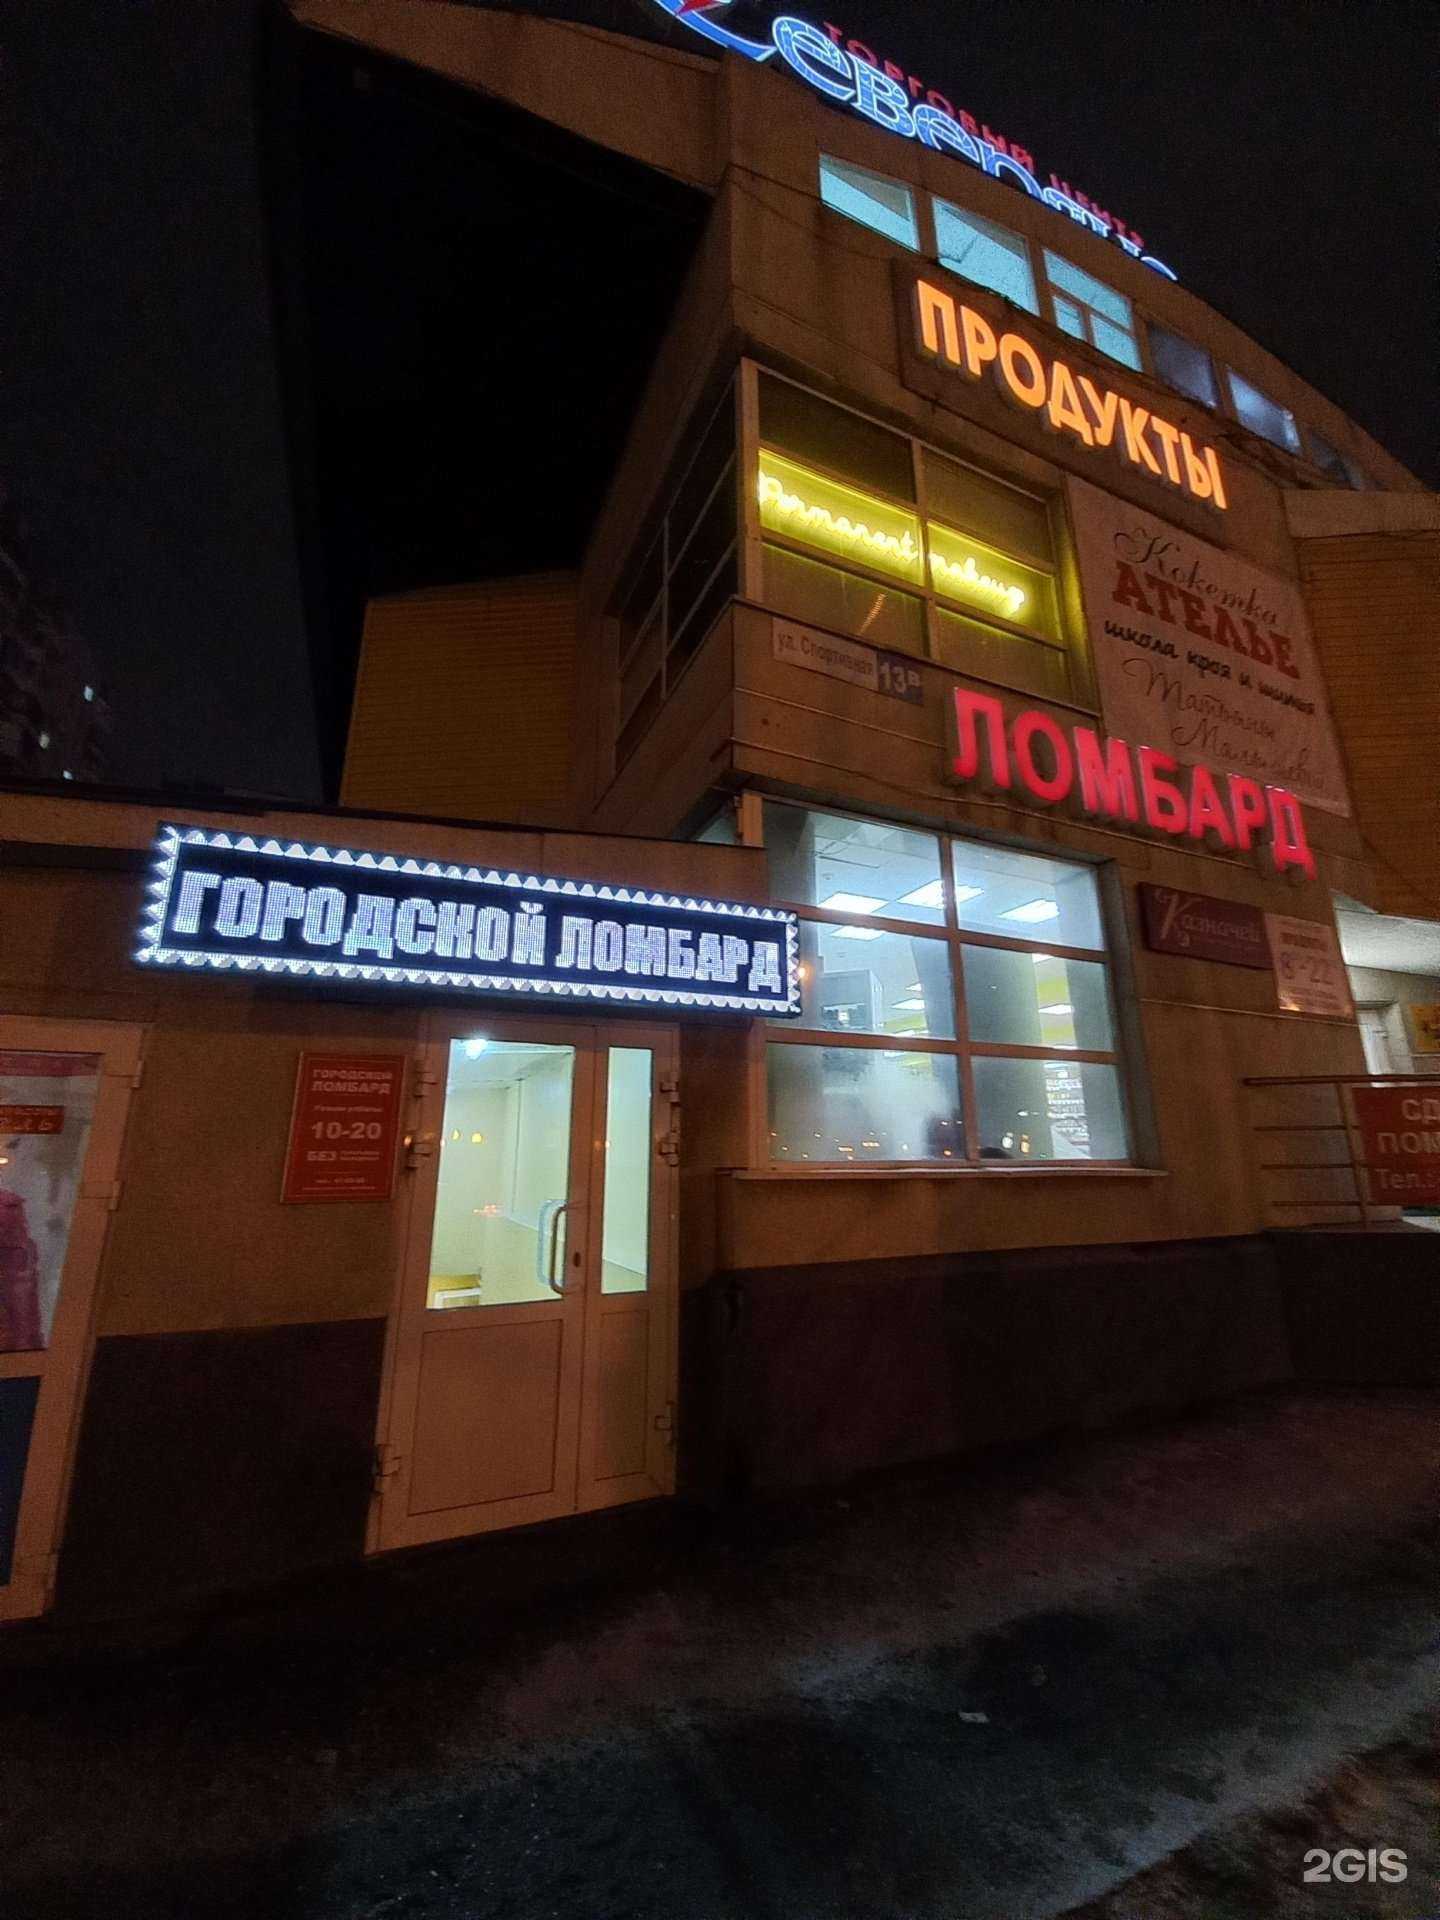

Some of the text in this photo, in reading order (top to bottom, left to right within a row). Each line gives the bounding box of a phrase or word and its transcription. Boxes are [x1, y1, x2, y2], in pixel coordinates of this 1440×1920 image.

[917, 279, 1228, 510] ПРОДУКТЫ
[1112, 559, 1301, 680] АТЕЛЬЕ
[954, 686, 1318, 881] ЛОМБАРД
[171, 867, 784, 994] ГОРОДСКОЙ ЛОМБАРД
[311, 1068, 393, 1080] ГОРОДСКОЙ
[311, 1081, 391, 1095] ЛОМБАРД
[311, 1121, 383, 1140] 10-20
